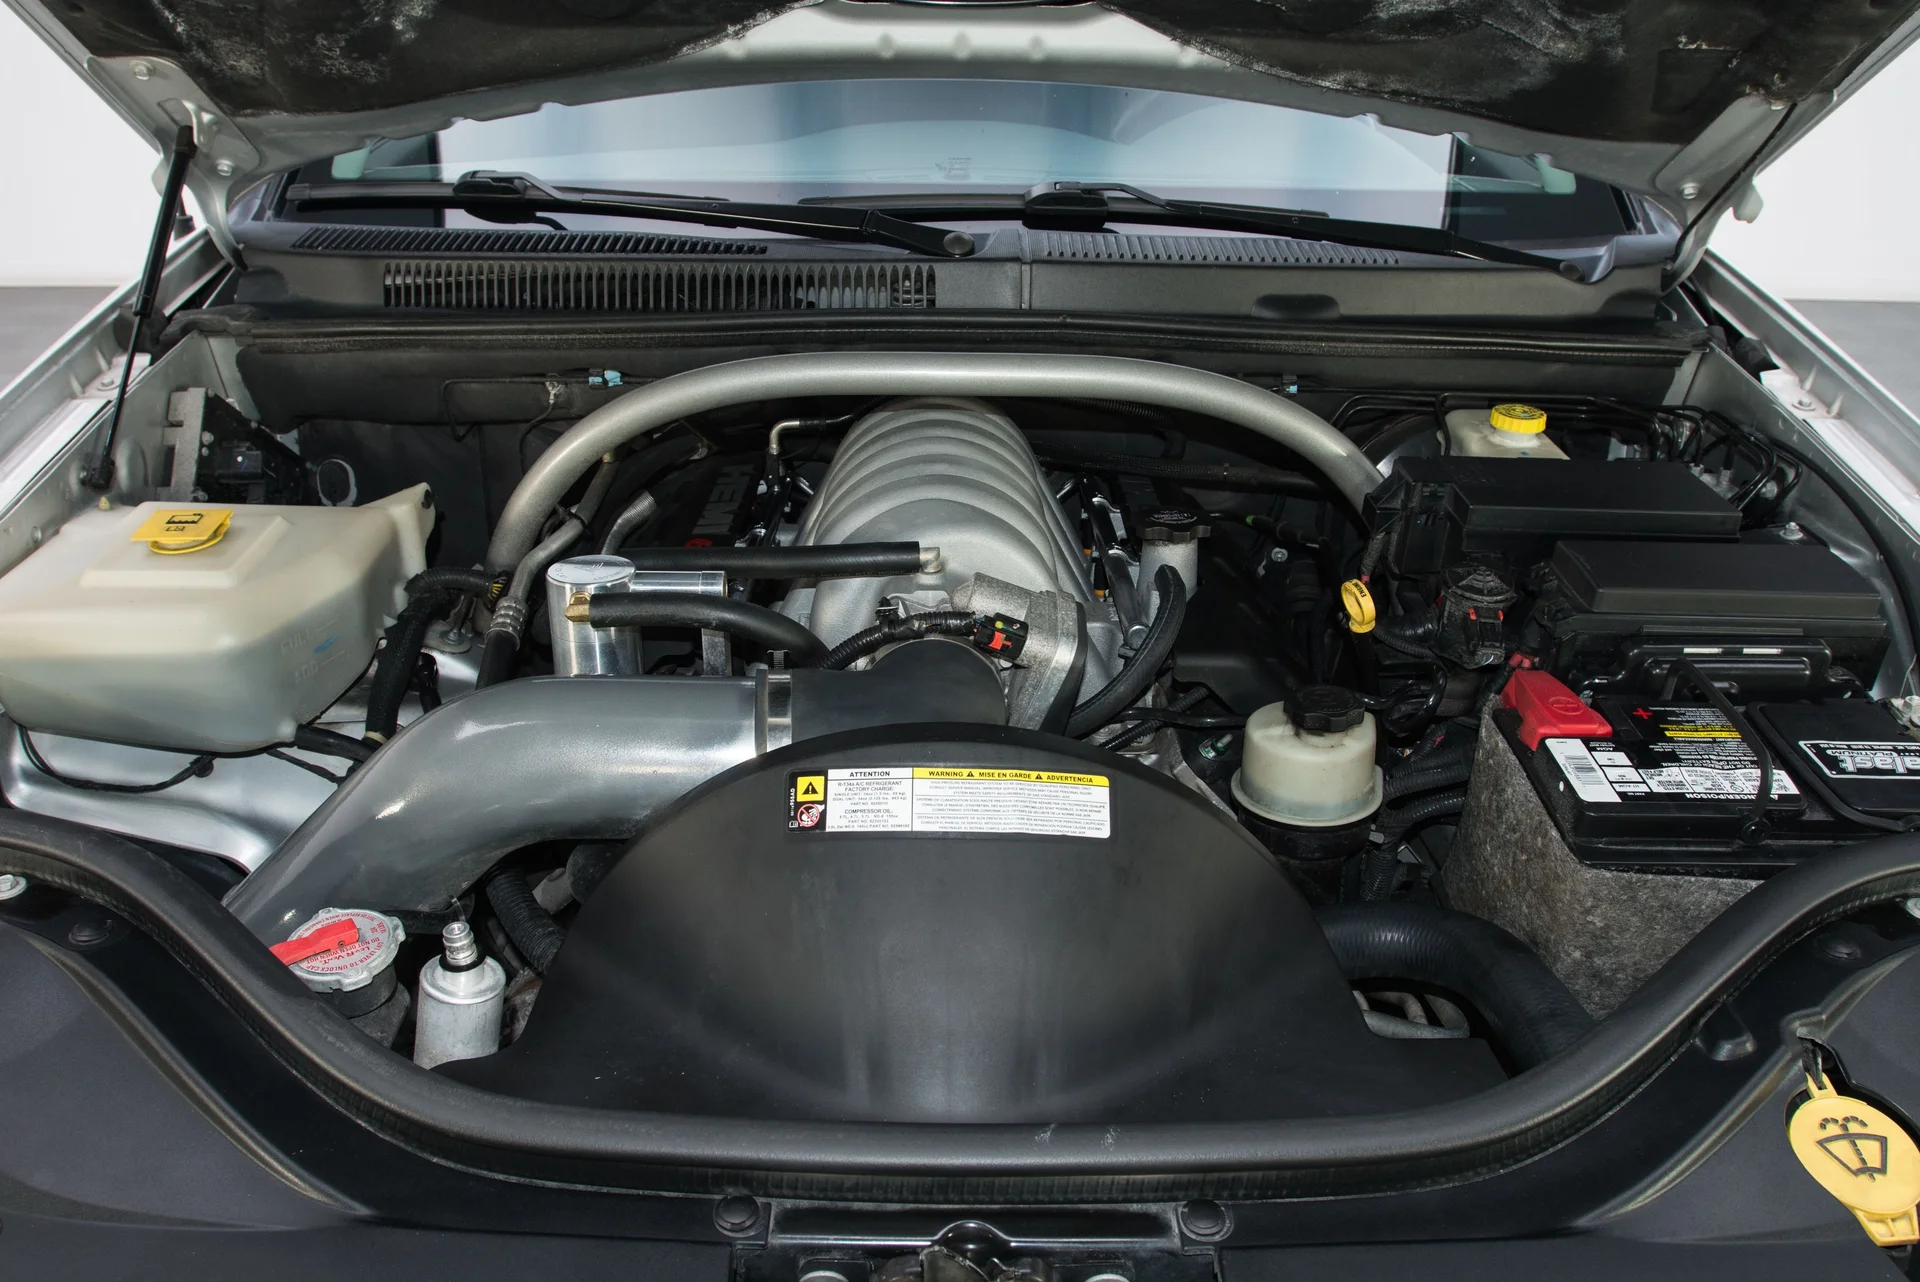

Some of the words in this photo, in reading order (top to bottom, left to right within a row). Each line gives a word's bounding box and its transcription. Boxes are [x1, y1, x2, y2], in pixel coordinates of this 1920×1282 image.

[1046, 775, 1093, 783] ADVERTENCIA
[357, 940, 370, 948] NOT
[339, 945, 357, 953] OPEN
[319, 950, 340, 959] WHEN
[358, 951, 376, 964] LEVER
[319, 964, 348, 972] UNLOCK
